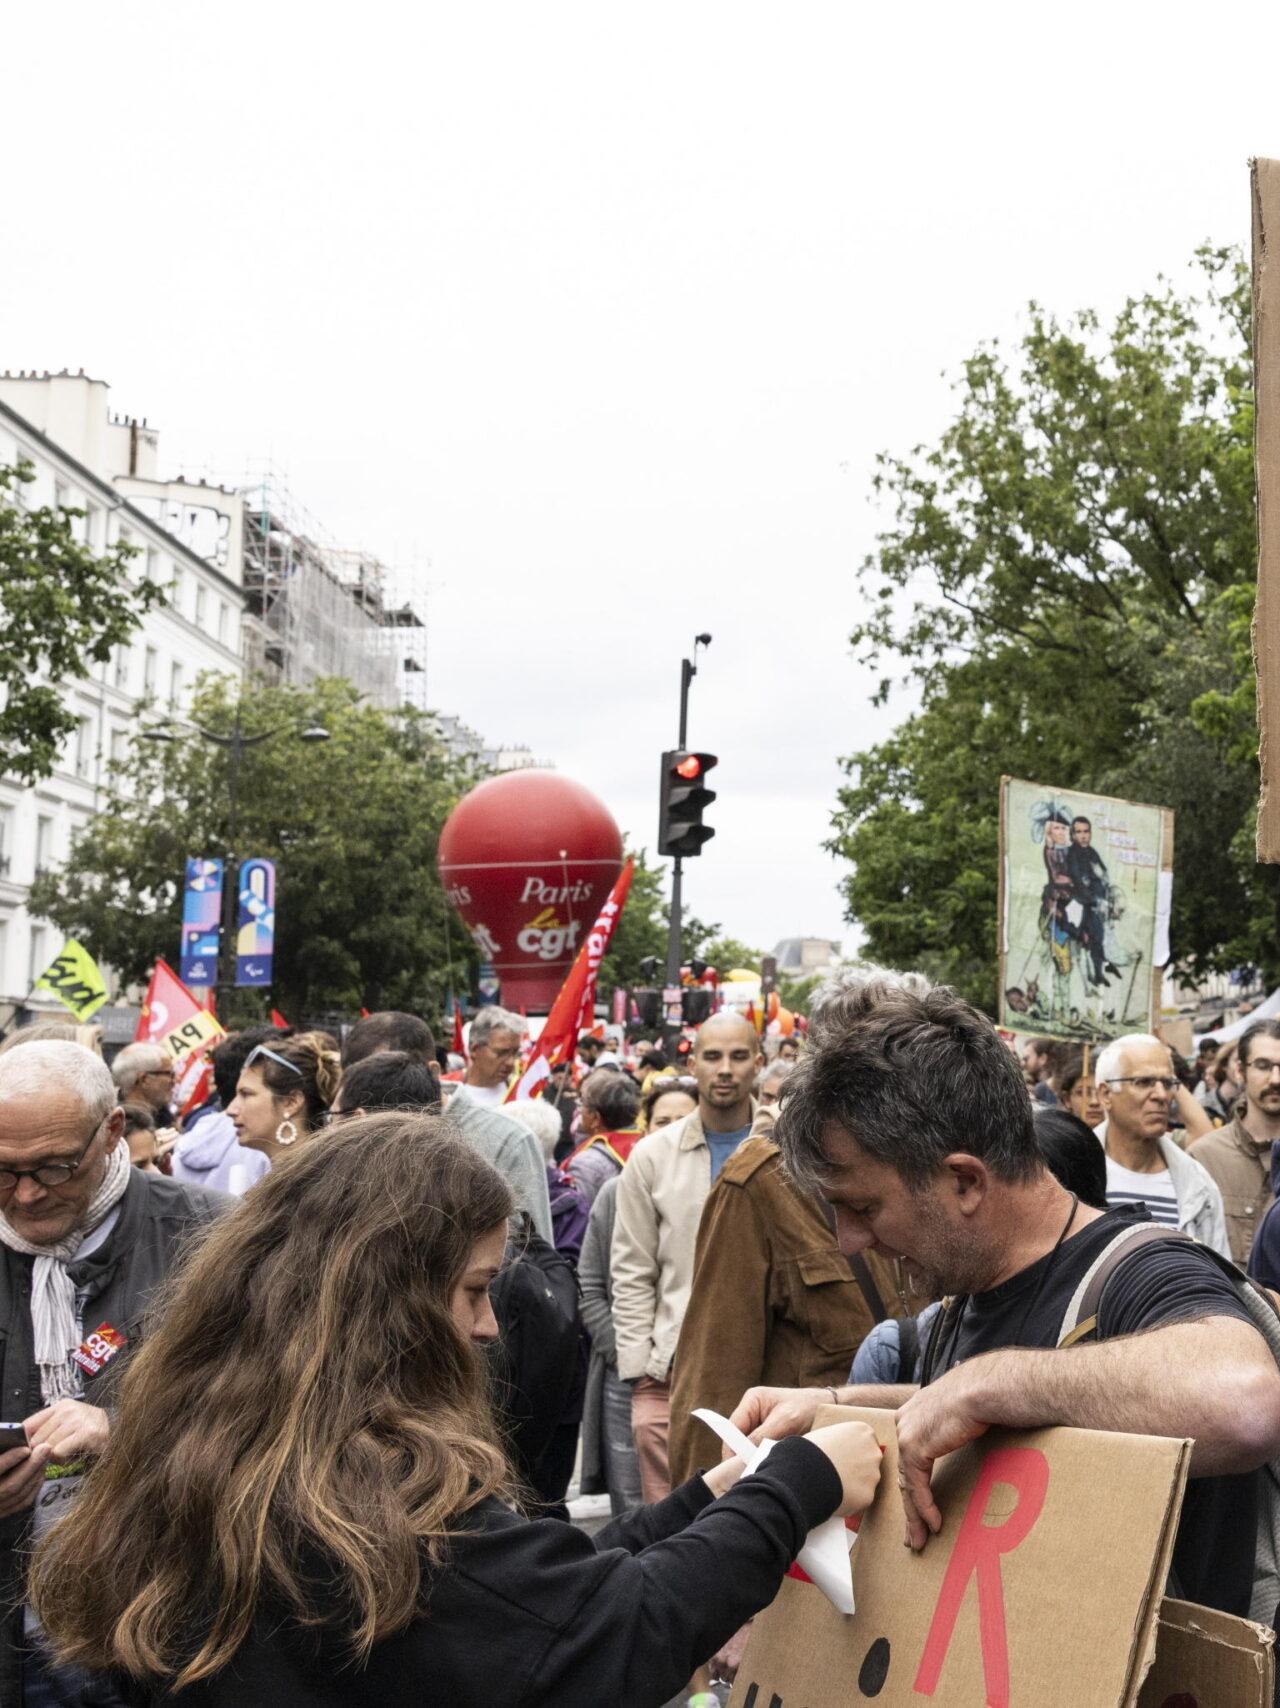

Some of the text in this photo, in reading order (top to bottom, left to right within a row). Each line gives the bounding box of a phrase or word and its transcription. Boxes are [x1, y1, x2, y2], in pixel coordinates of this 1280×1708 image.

[520, 877, 593, 905] Paris
[517, 920, 581, 960] cgt
[87, 1334, 118, 1361] cgt
[913, 1447, 1050, 1708] R
